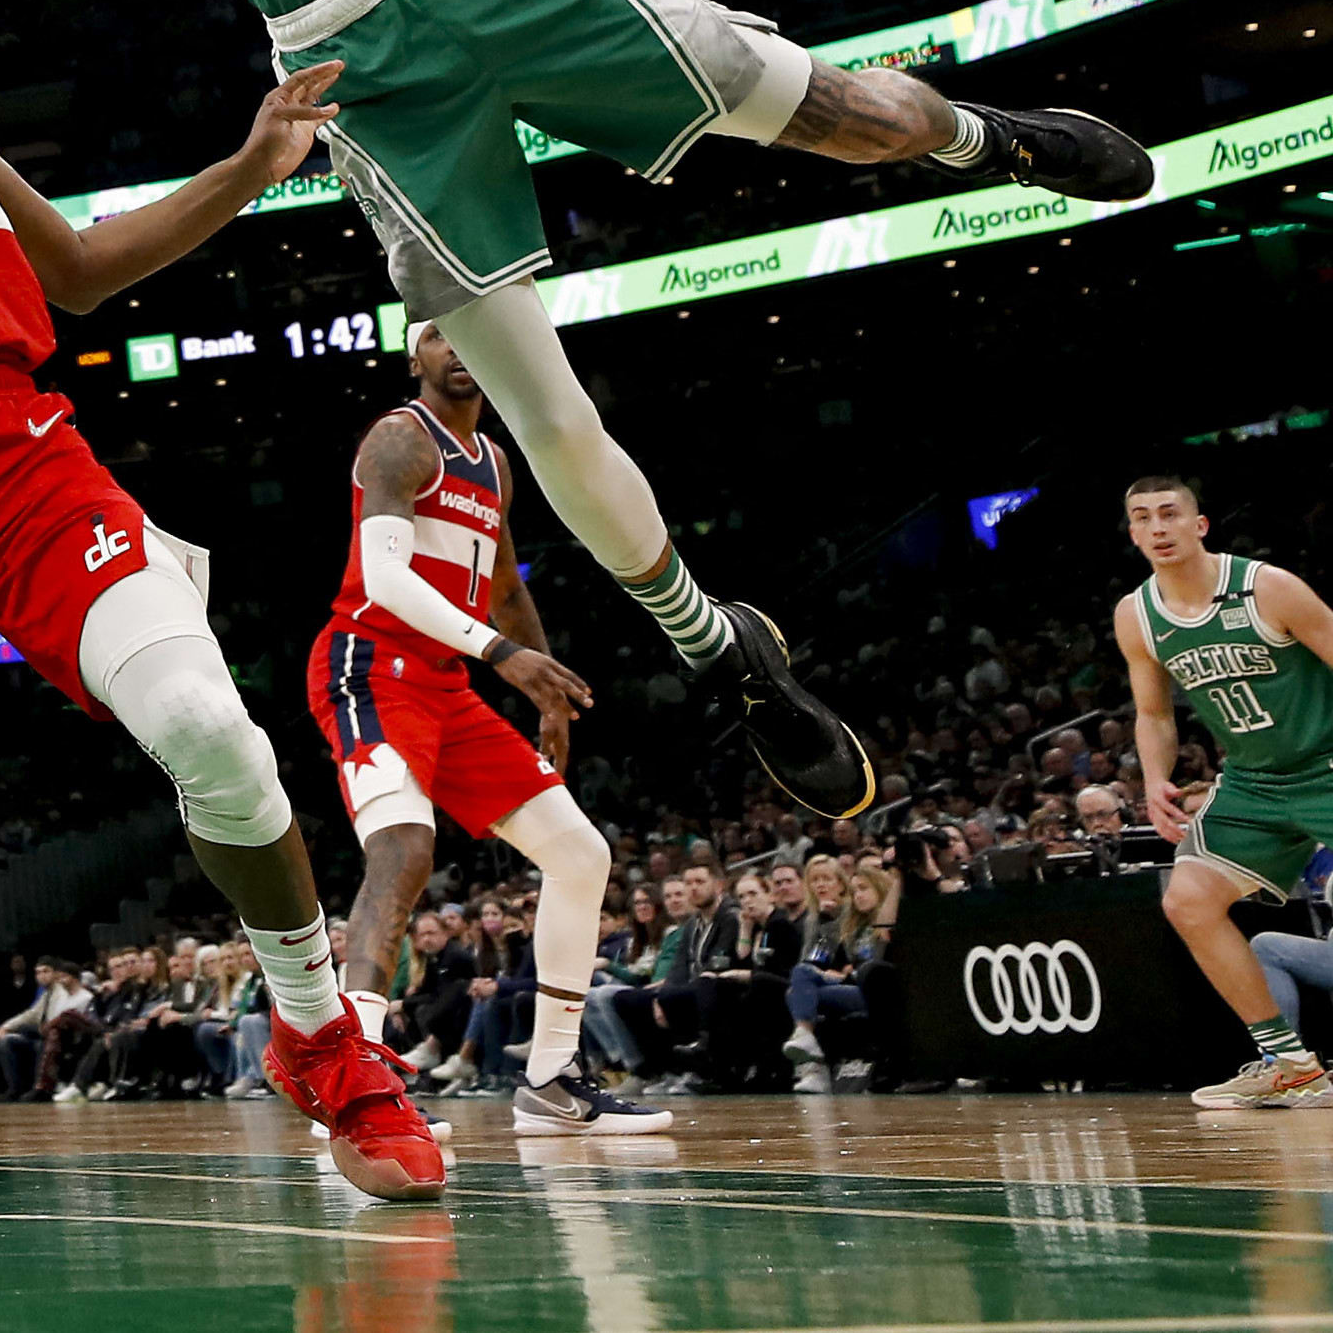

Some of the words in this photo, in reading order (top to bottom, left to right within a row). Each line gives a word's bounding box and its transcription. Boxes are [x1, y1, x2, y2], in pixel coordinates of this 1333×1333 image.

[1206, 113, 1333, 174] Algorand
[933, 196, 1068, 239] Algorand
[659, 250, 781, 294] Algorand
[182, 331, 256, 361] Bank
[284, 312, 376, 358] 1:42
[467, 538, 480, 607] 1
[1208, 680, 1274, 734] 11
